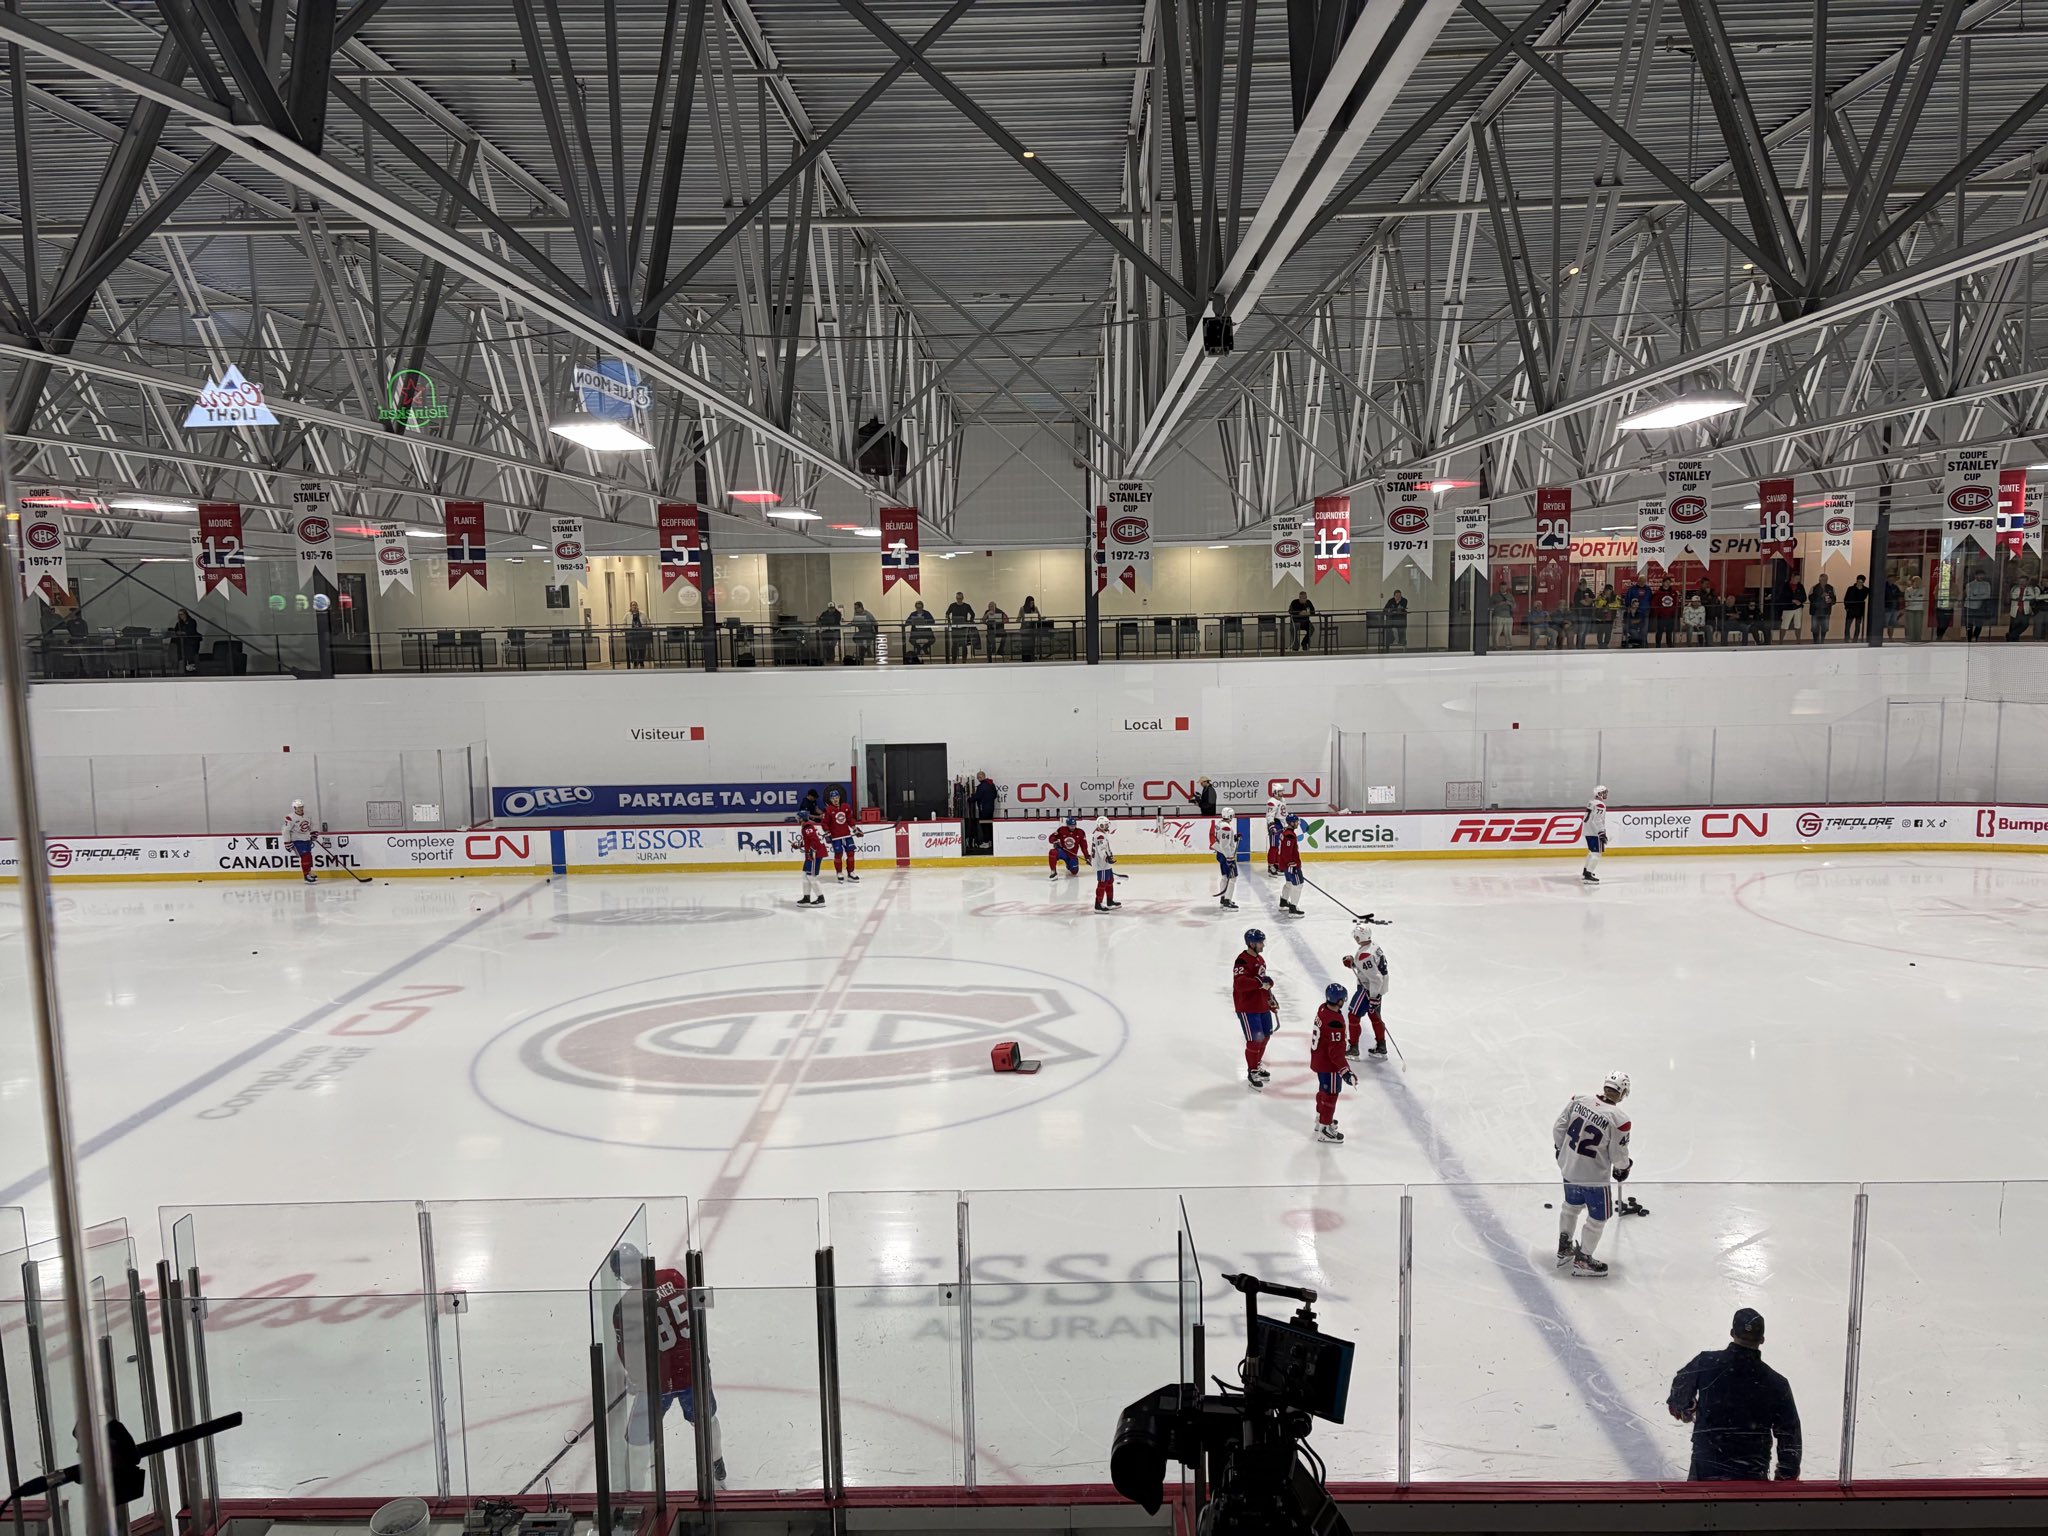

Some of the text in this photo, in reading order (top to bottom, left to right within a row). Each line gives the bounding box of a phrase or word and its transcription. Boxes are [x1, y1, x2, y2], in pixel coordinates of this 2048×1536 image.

[1960, 451, 1988, 460] COUPE
[1678, 462, 1702, 470] COUPE
[1948, 460, 1999, 471] STANLEY
[1668, 471, 1711, 481] STANLEY
[1964, 473, 1982, 481] CUP
[301, 483, 321, 491] COUPE
[1119, 483, 1143, 491] COUPE
[1387, 482, 1432, 492] STANLEY
[1682, 483, 1697, 491] CUP
[29, 489, 50, 497] COUPE
[293, 492, 330, 503] STANLEY
[1109, 492, 1152, 503] STANLEY
[1401, 494, 1417, 502] CUP
[2025, 493, 2043, 501] NLEY
[306, 504, 318, 512] CUP
[1123, 504, 1138, 512] CUP
[1543, 503, 1566, 511] DRYDEN
[453, 516, 477, 525] PLANTE
[1315, 511, 1350, 520] COURNOYER
[1456, 515, 1487, 523] STANLEY
[208, 518, 233, 528] MOORE
[661, 518, 696, 527] GEOFFRION
[1273, 523, 1302, 531] STANLEY
[1763, 510, 1791, 543] 18
[1947, 520, 1993, 530] 1967-68
[552, 525, 582, 533] STANLEY
[1538, 518, 1568, 550] 29
[1669, 530, 1707, 539] 1968-69
[374, 531, 405, 539] STANLEY
[2022, 532, 2040, 540] 15-16
[459, 532, 474, 563] 1
[1317, 528, 1347, 558] 12
[1387, 541, 1428, 550] 1970-71
[205, 536, 242, 568] 12
[671, 535, 689, 567] 5
[890, 538, 910, 570] 4
[1570, 541, 1638, 558] PORTIV
[300, 551, 333, 560] 1975-76
[1111, 551, 1150, 561] 1972-73
[28, 557, 62, 566] 1976-77
[556, 562, 584, 570] 1952-53
[1125, 718, 1164, 730] Local
[631, 729, 686, 740] Visiteur
[1212, 778, 1260, 789] omplexe
[1143, 780, 1195, 800] CN
[1223, 789, 1258, 801] sportif
[505, 786, 798, 814] OREO PARTAGE TA JOIE
[1099, 791, 1134, 803] sportif
[1622, 813, 1691, 827] Complexe
[1702, 812, 1768, 838] CN
[1826, 816, 1895, 826] TRICOLORE
[1999, 818, 2048, 833] Bumpe
[1325, 824, 1394, 843] kersia
[1645, 827, 1689, 841] sportif
[387, 835, 455, 850] Complexe
[620, 829, 704, 850] ESSOR
[466, 834, 529, 859] CN
[75, 848, 142, 857] TRICOLORE
[411, 849, 454, 863] sportif
[219, 855, 360, 869] CANADIESMTL
[1234, 966, 1244, 976] 22
[1362, 960, 1373, 971] 48
[1331, 1032, 1341, 1042] 13
[1574, 1103, 1610, 1131] ENGSTRÖM
[1566, 1116, 1604, 1159] 42
[1619, 1132, 1631, 1147] 42
[655, 1281, 677, 1300] KIER
[657, 1293, 690, 1352] 85
[910, 1314, 1250, 1343] ASSURANCE
